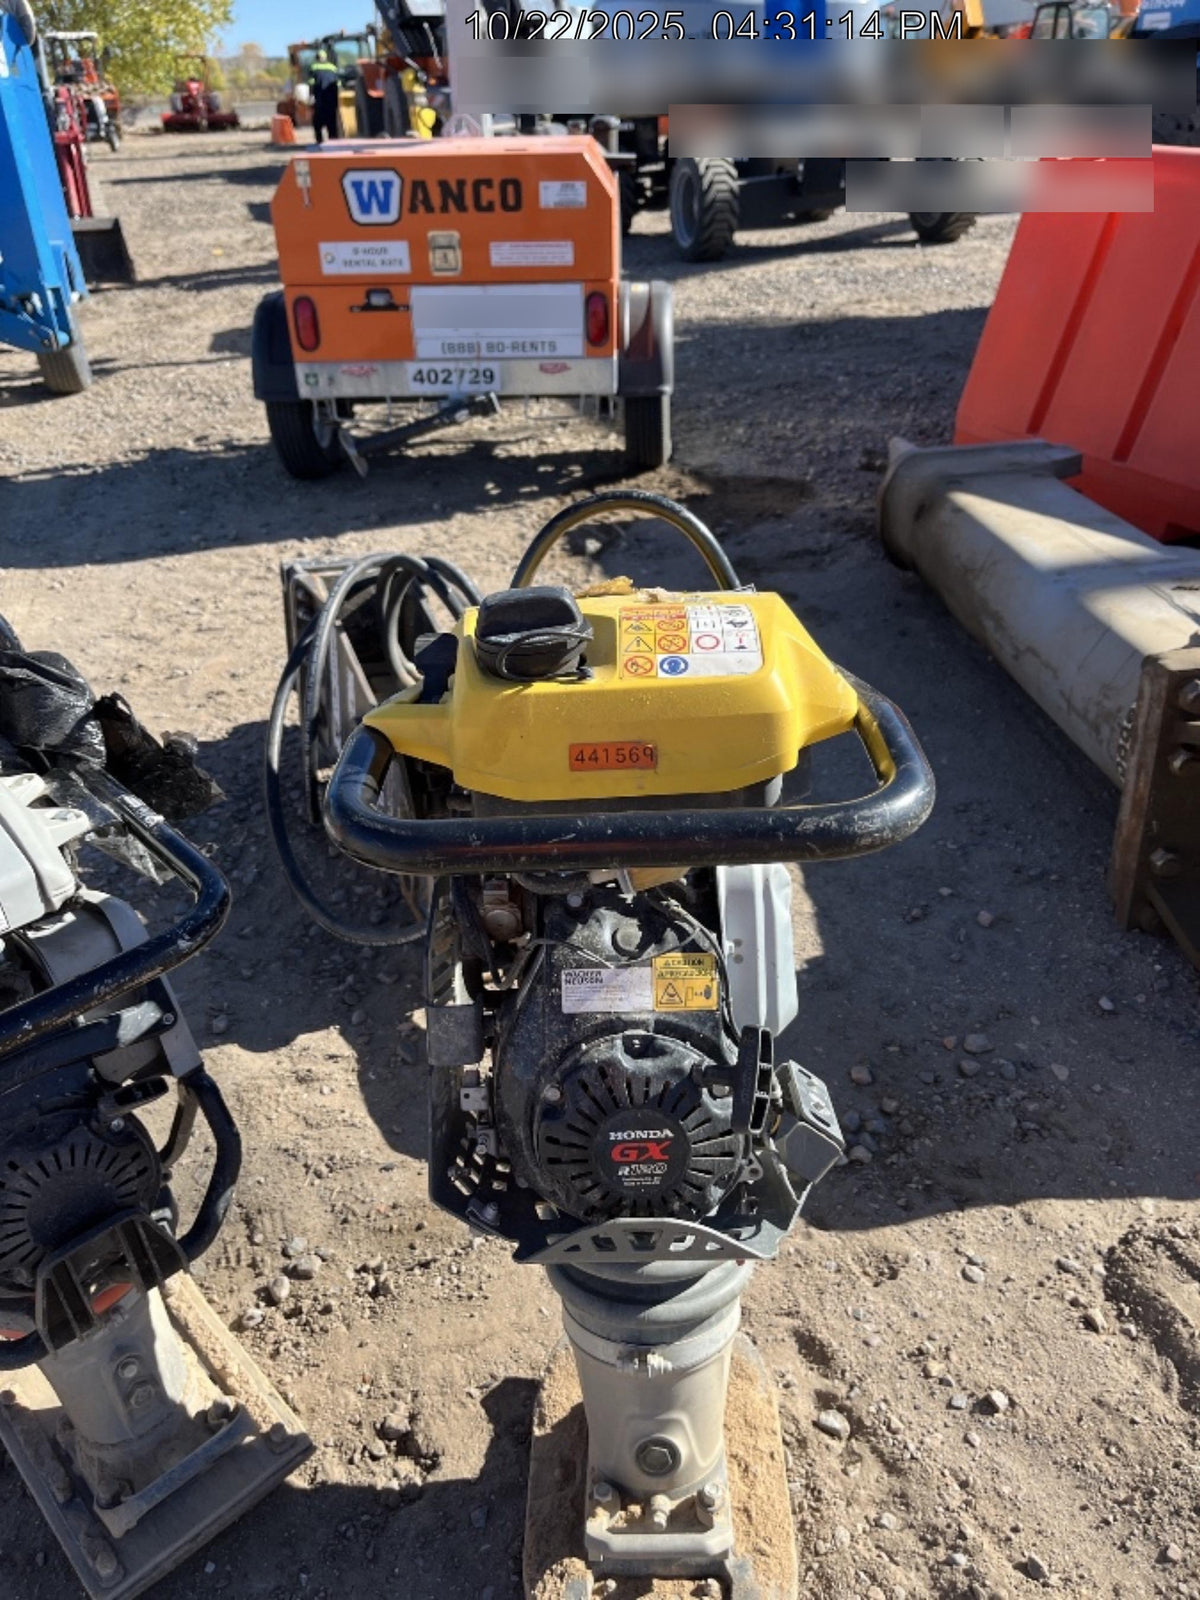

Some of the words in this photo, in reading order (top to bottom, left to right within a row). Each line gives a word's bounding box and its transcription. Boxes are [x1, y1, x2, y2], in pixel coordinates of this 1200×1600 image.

[350, 178, 523, 215] WANCO
[412, 368, 495, 385] 402729
[574, 746, 654, 764] 441569
[609, 1128, 674, 1140] HONDA
[611, 1141, 671, 1162] GX
